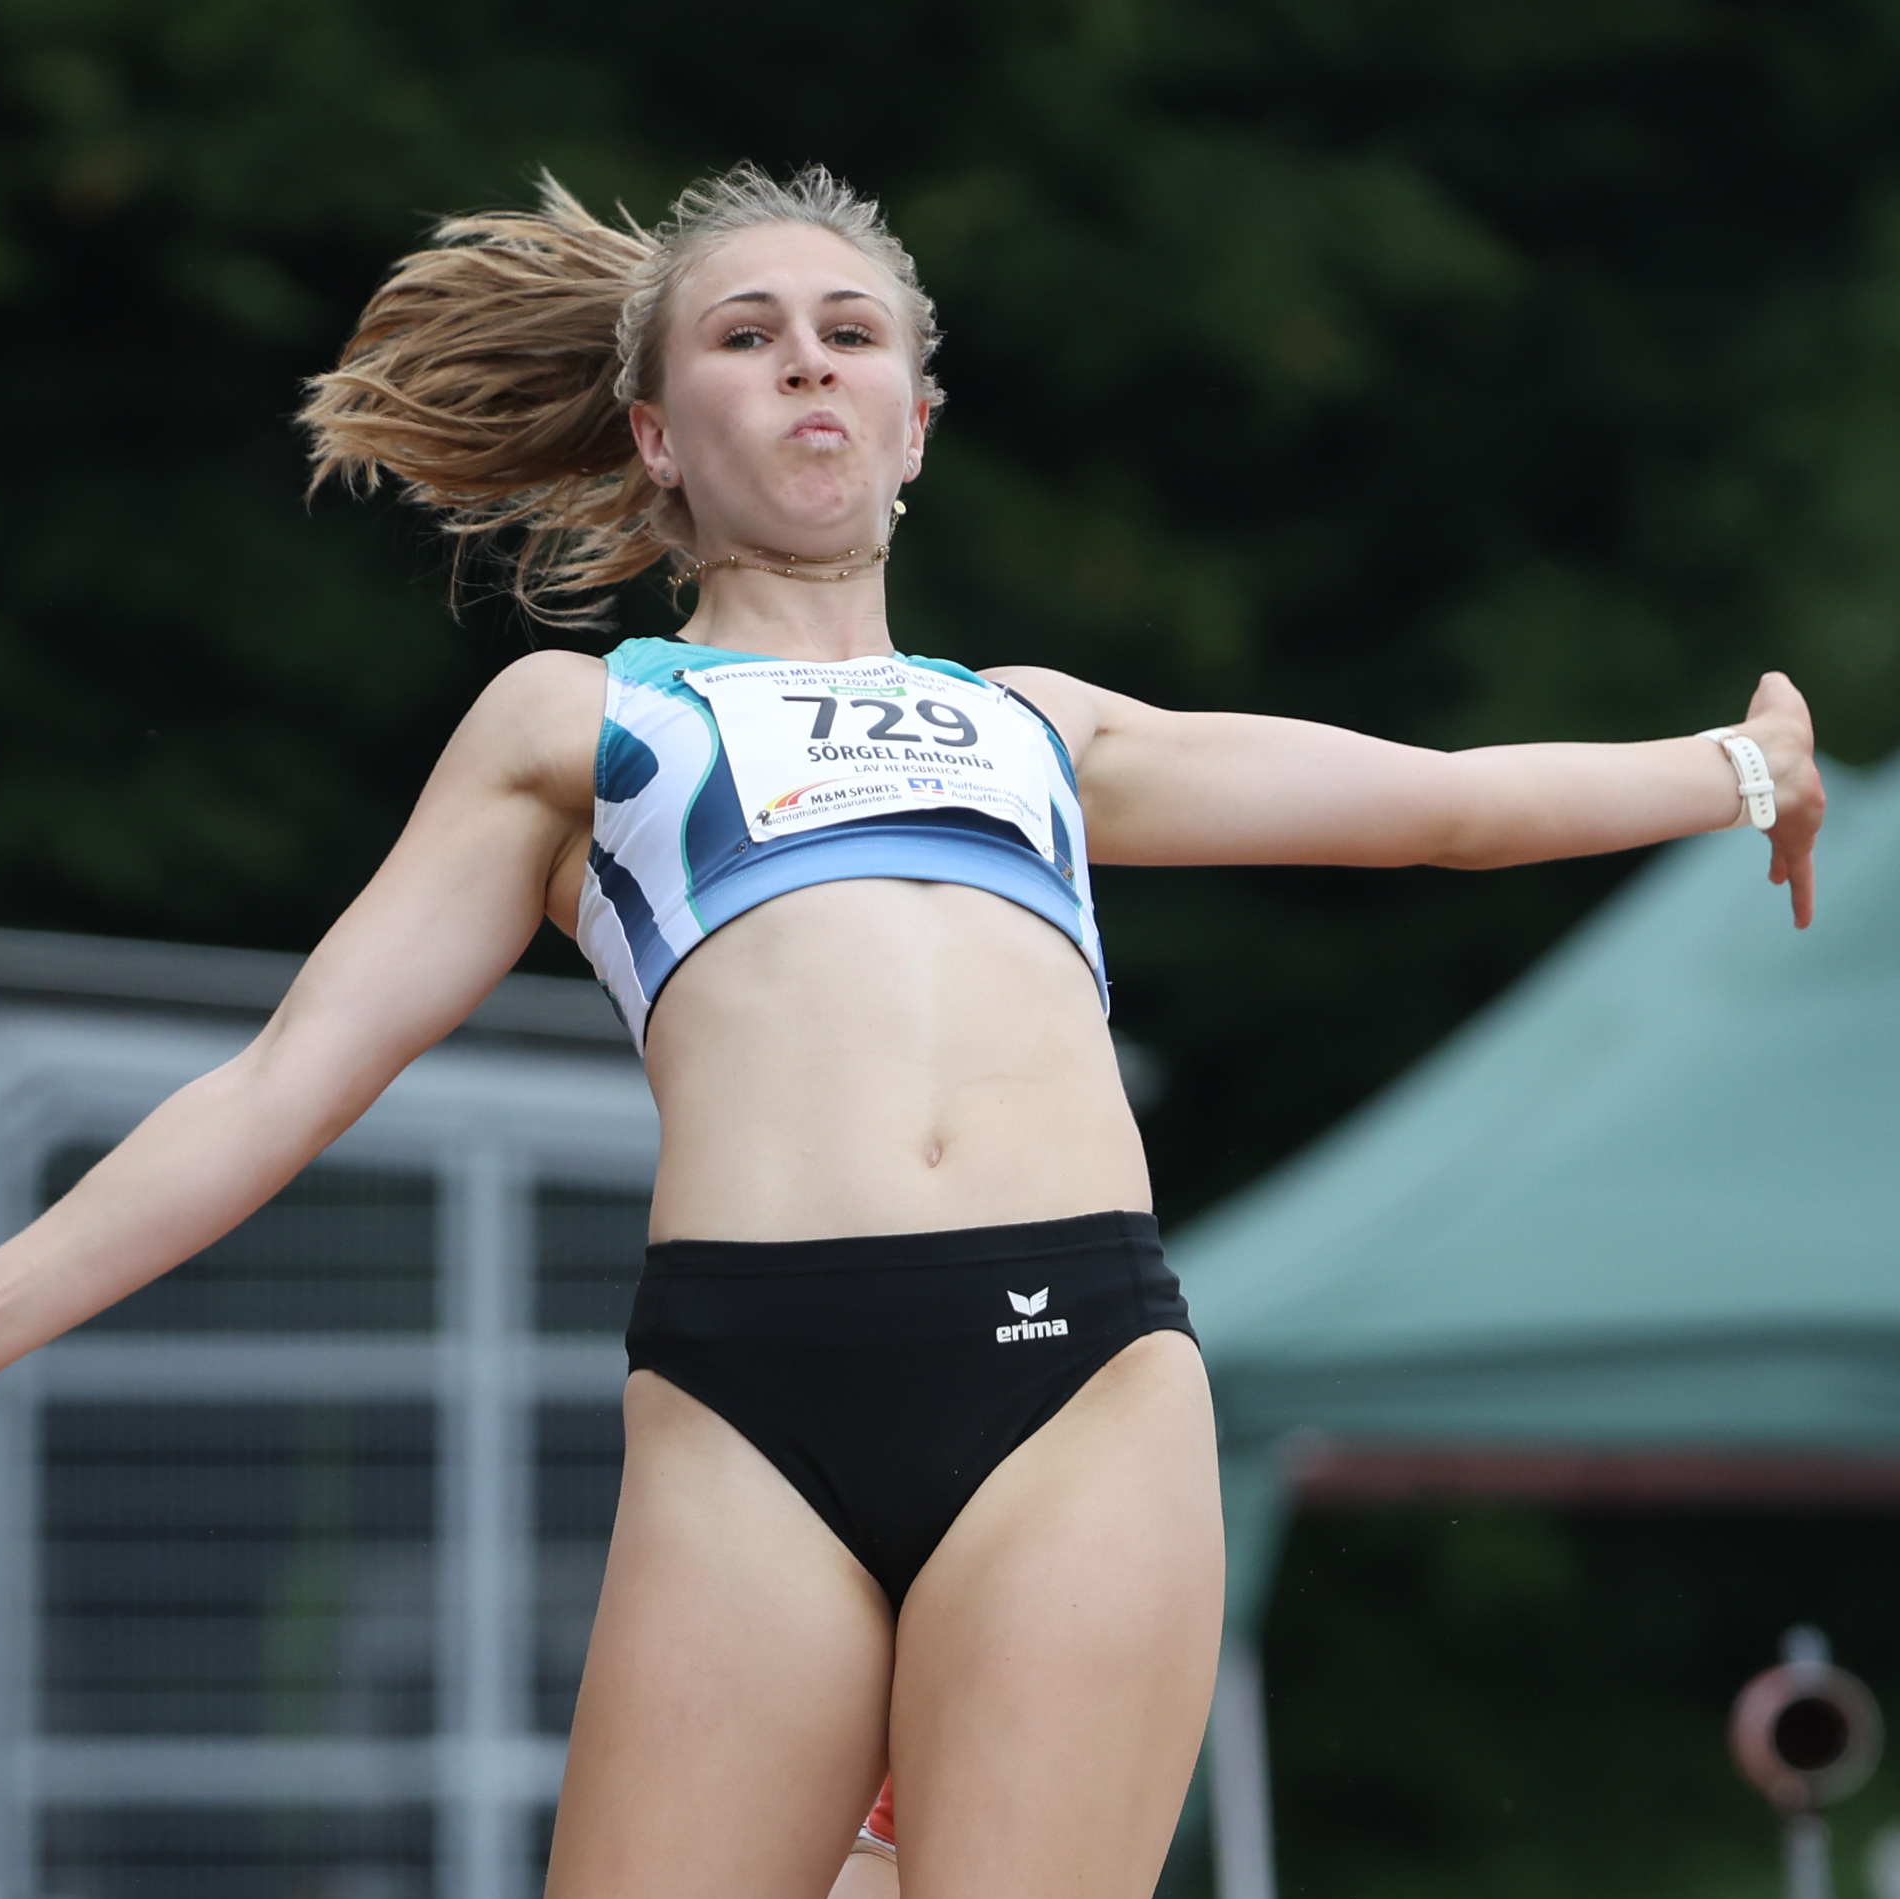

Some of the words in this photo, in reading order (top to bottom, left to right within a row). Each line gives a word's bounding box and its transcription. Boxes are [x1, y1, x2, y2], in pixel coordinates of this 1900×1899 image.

[703, 669, 788, 684] BAYERISCHE
[781, 696, 978, 748] 729
[807, 741, 900, 762] SÖRGEL
[904, 748, 995, 771] Antonia
[854, 764, 880, 773] LAV
[884, 764, 963, 776] HERSBRUCK
[810, 789, 847, 806] M&M
[848, 783, 900, 797] SPORTS
[996, 1319, 1069, 1344] erima
